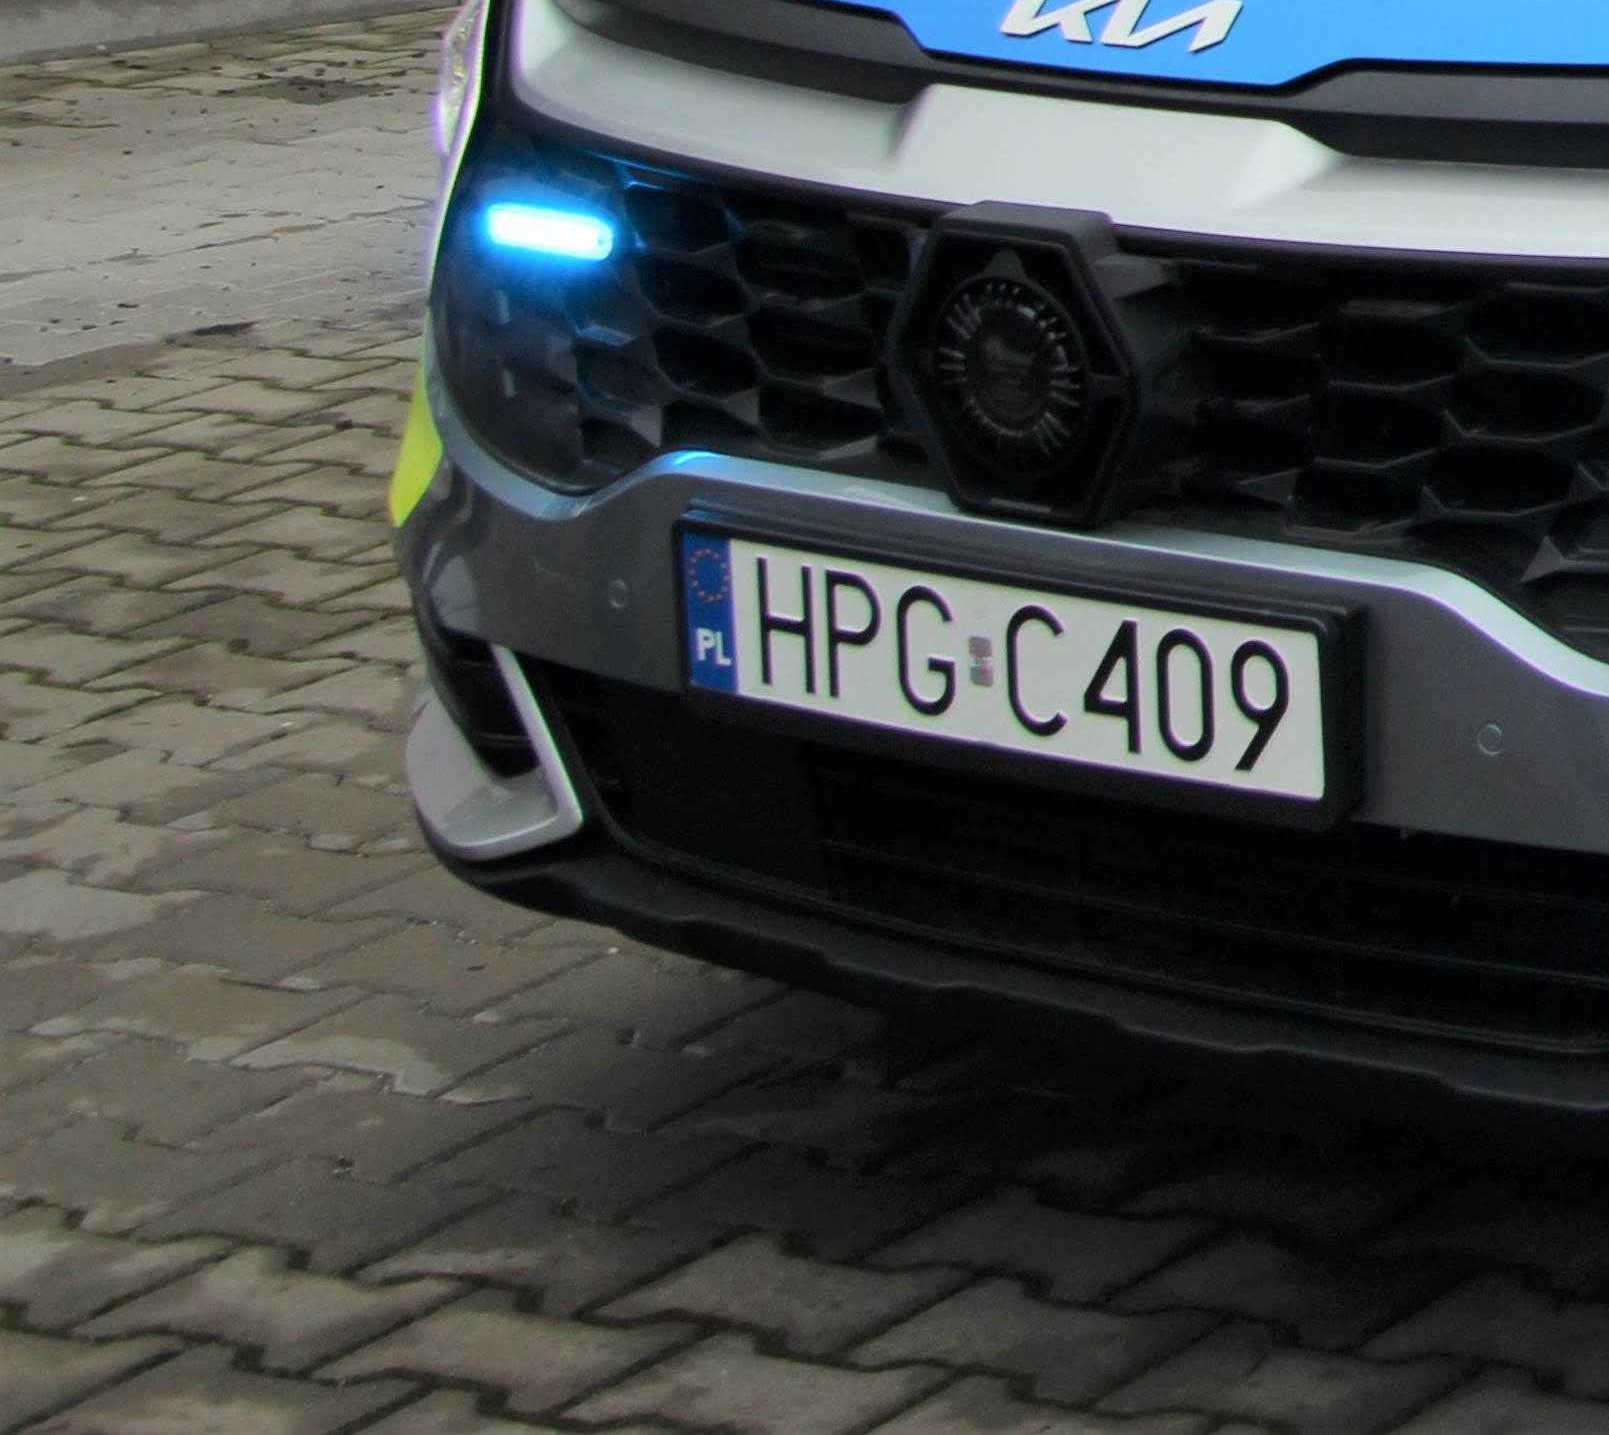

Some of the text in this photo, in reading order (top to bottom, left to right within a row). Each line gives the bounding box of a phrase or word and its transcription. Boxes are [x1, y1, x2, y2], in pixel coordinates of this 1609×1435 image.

[695, 627, 732, 667] PL
[756, 556, 1291, 772] HPG C409
